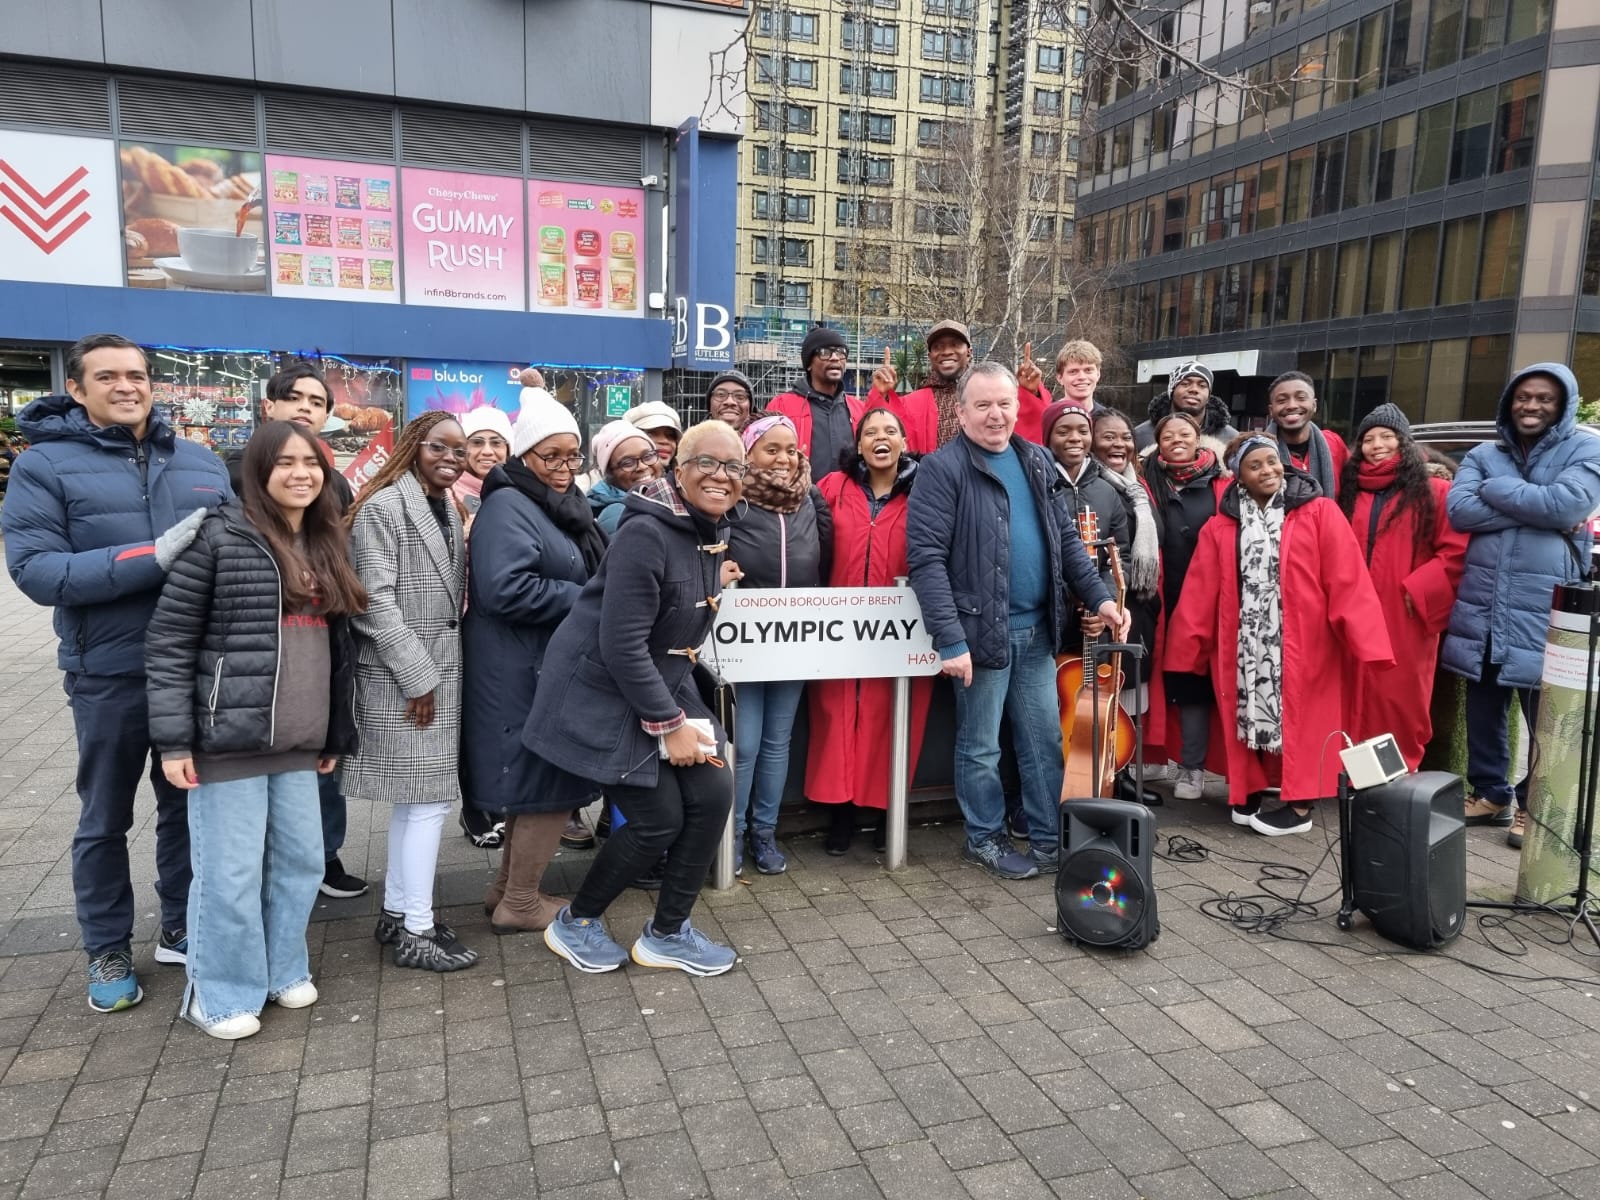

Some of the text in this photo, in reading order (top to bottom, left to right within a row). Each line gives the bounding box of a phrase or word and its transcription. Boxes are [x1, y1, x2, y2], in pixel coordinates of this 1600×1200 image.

[412, 202, 514, 239] GUMMY
[427, 239, 504, 272] RUSH
[695, 302, 731, 351] B
[434, 369, 484, 384] blu.bar
[734, 595, 904, 608] LONDON BOROUGH OF BRENT
[715, 619, 918, 644] OLYMPIC WAY
[908, 652, 936, 665] HA9
